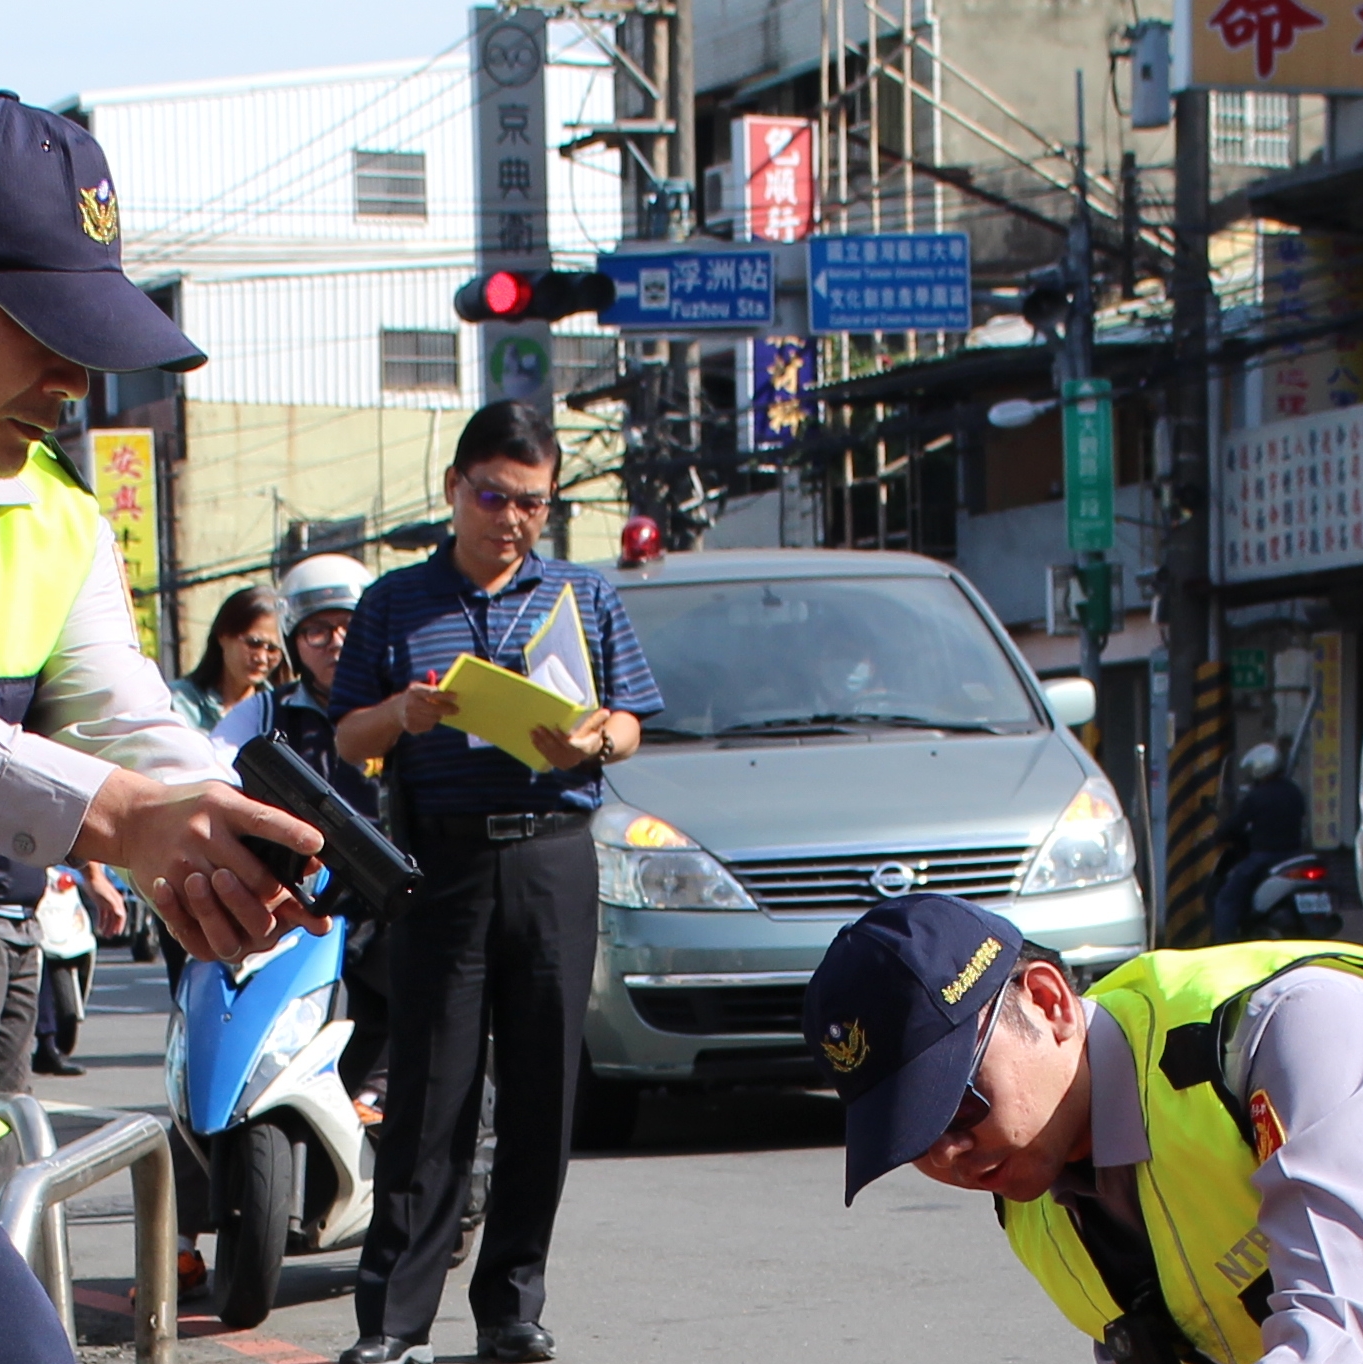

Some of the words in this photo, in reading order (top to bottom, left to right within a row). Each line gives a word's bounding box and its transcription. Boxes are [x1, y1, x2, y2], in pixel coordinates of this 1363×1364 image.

[672, 259, 768, 293] 浮洲站
[672, 299, 730, 319] Fuzhou
